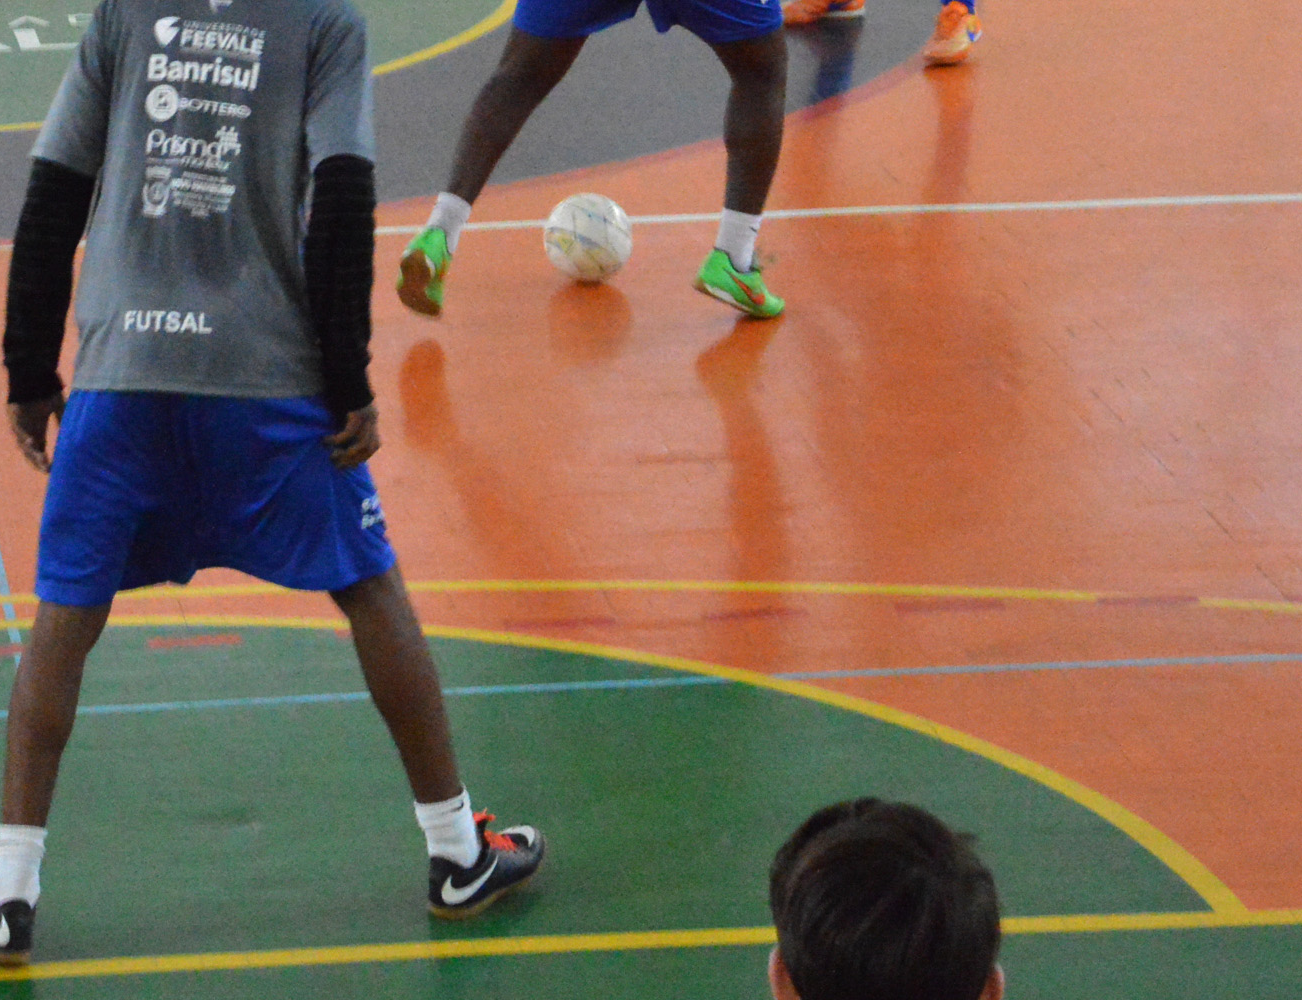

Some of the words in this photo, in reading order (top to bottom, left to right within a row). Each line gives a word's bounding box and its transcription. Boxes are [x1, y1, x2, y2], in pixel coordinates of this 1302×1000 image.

[179, 28, 266, 56] FEEVALE
[147, 53, 261, 92] Banrisul
[123, 309, 213, 334] FUTSAL
